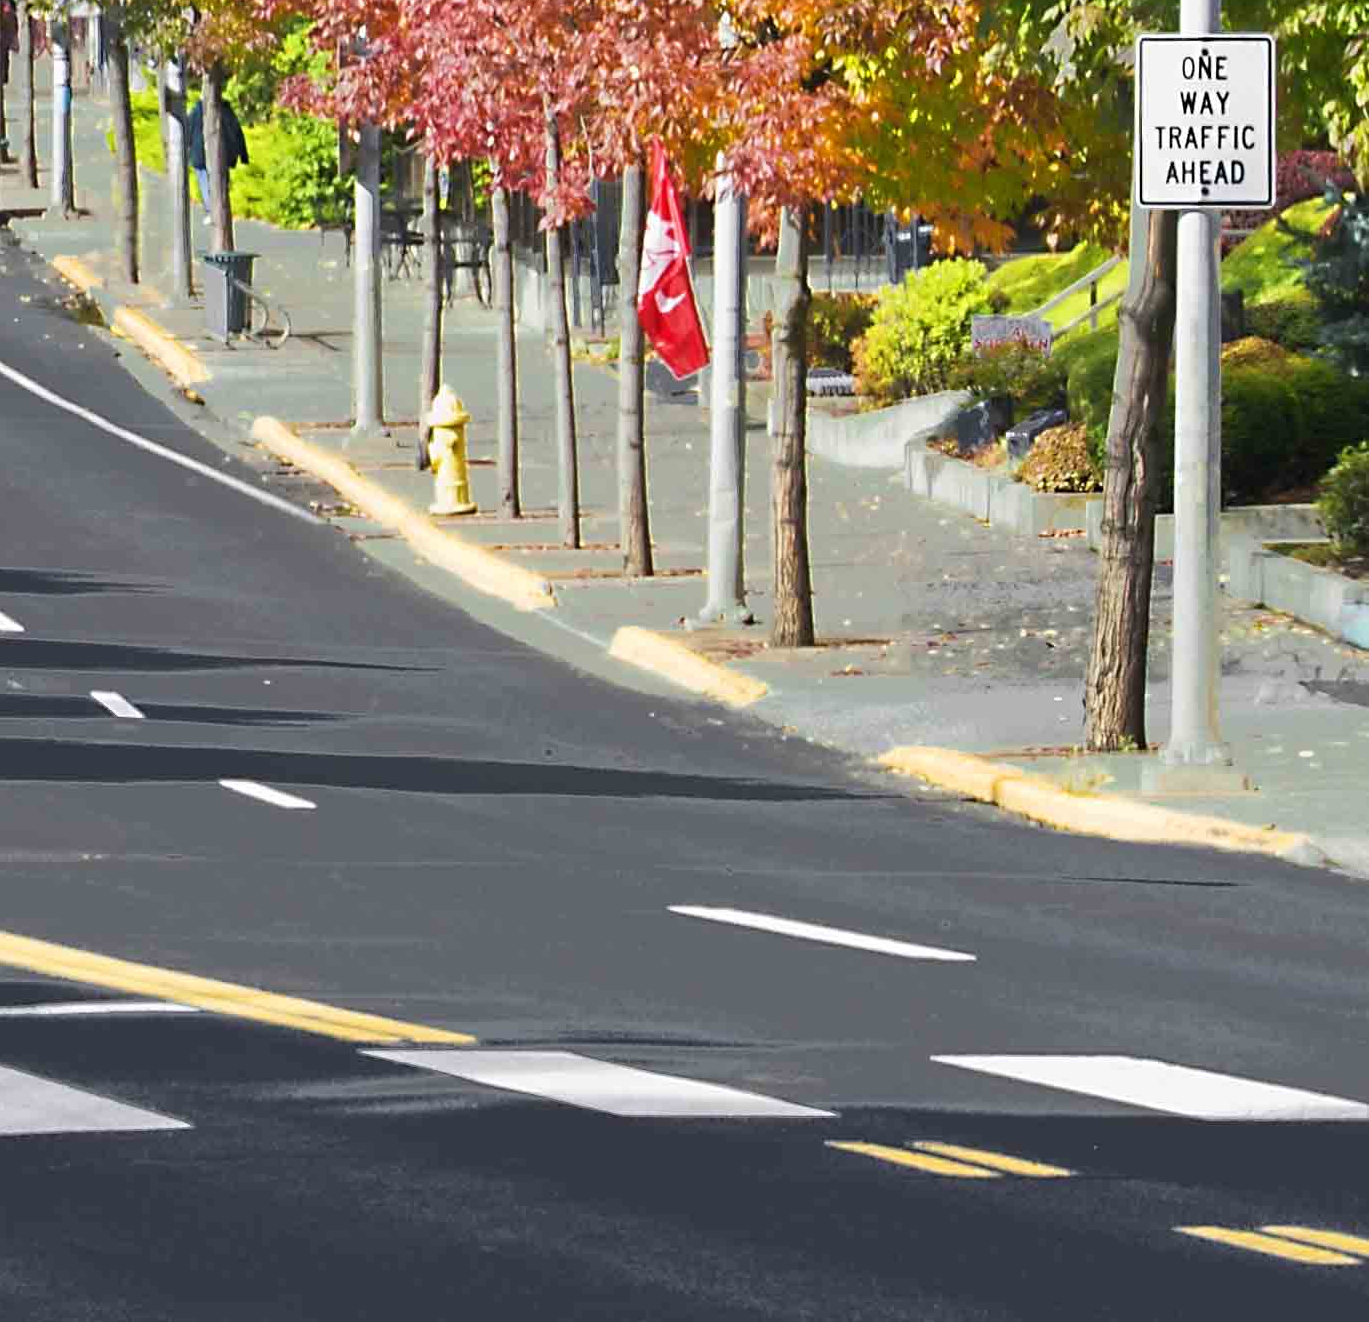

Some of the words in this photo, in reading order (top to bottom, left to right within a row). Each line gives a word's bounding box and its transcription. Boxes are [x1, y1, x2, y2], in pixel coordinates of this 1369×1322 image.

[1182, 56, 1228, 80] ONE
[1180, 91, 1230, 115] WAY
[1155, 126, 1255, 150] TRAFFIC
[1166, 160, 1245, 185] AHEAD
